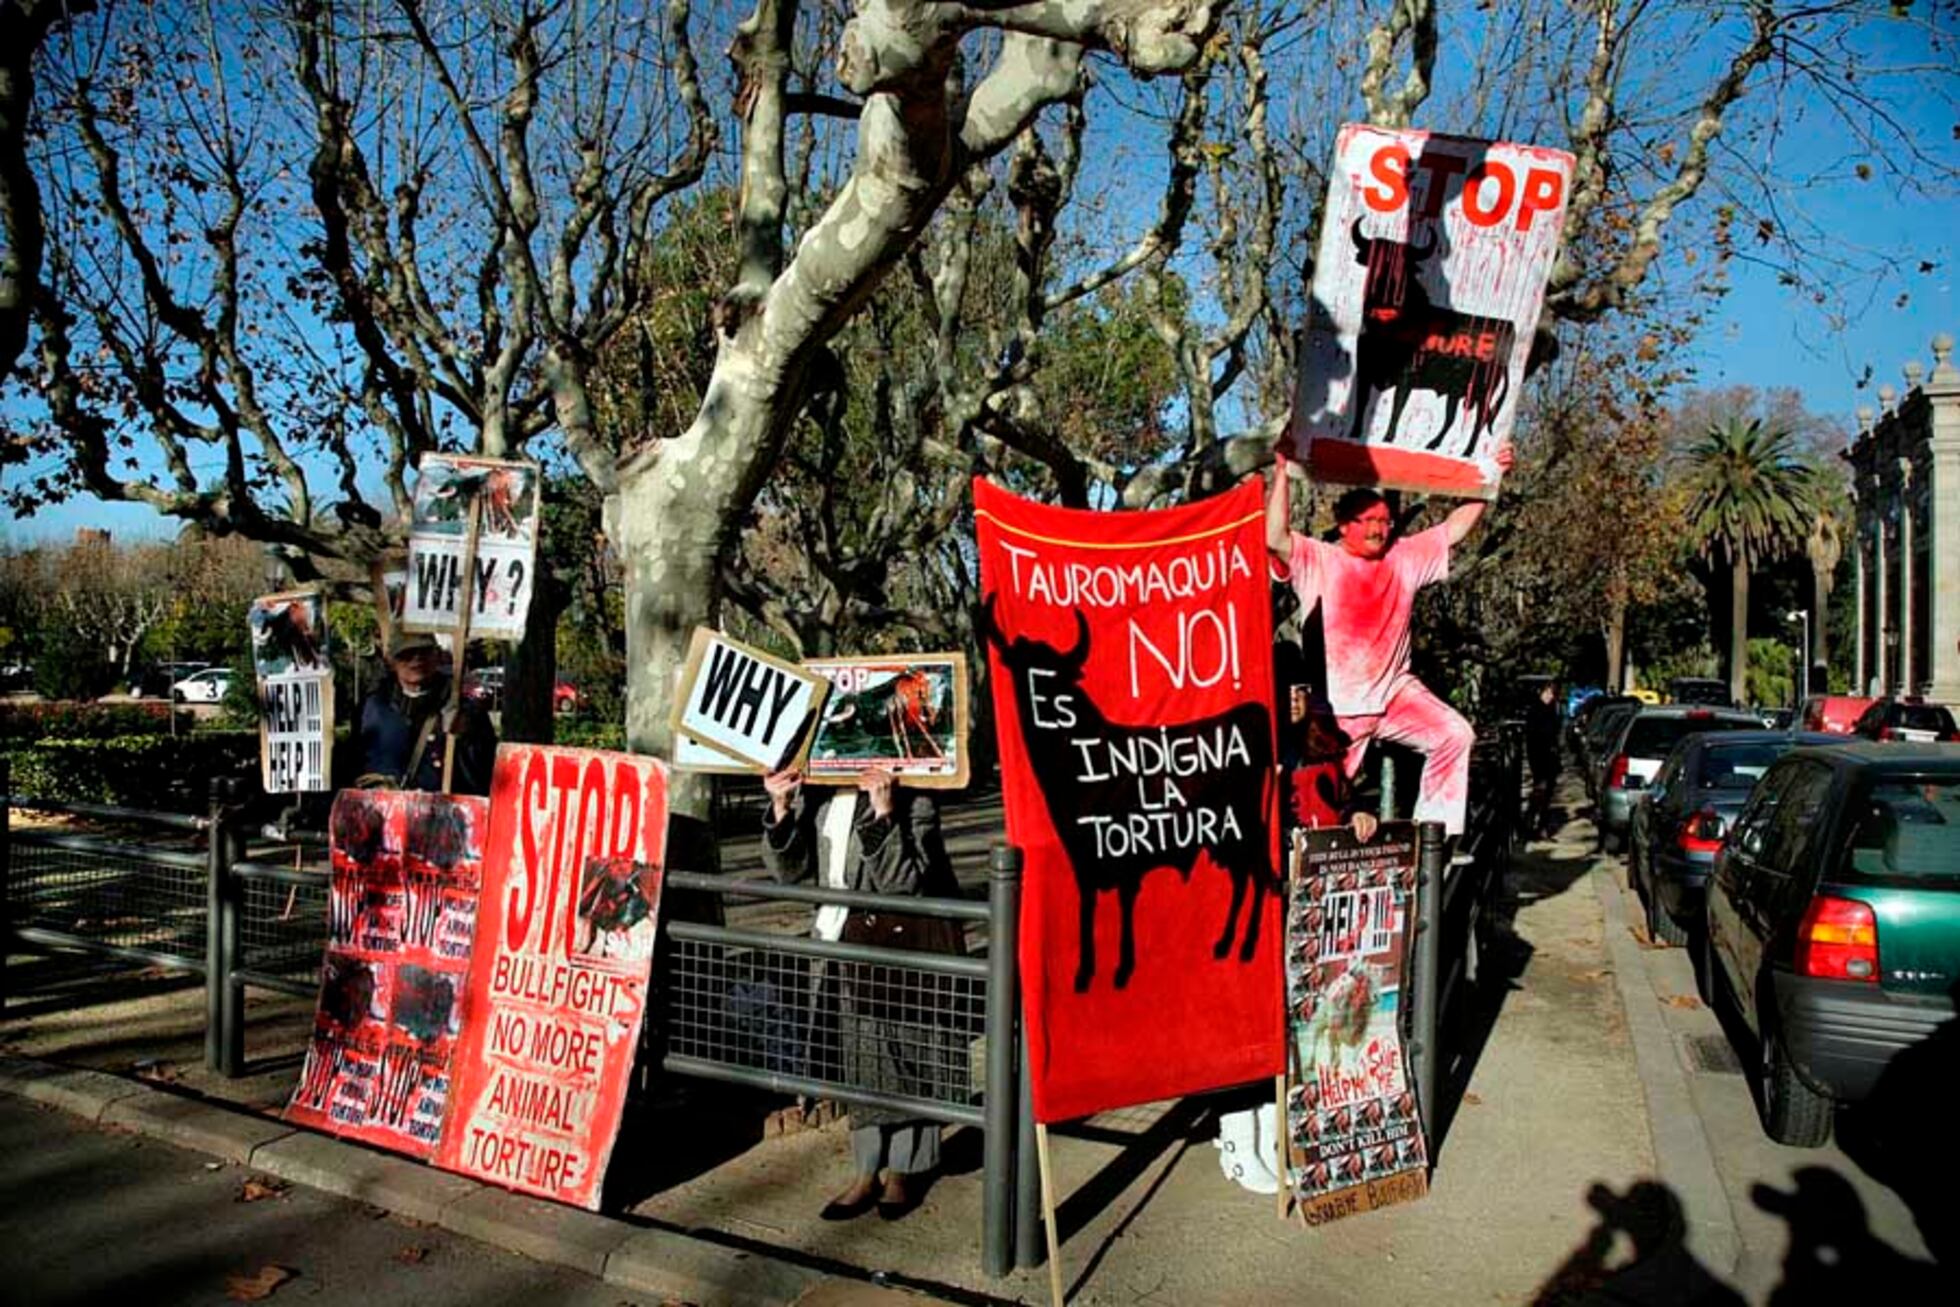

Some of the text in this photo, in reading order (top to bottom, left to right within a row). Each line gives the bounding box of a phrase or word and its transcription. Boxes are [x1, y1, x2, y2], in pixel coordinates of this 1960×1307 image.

[1362, 143, 1563, 233] STOP
[1128, 601, 1242, 698] NO!
[265, 683, 303, 733] HELP
[698, 643, 802, 748] WHY
[269, 741, 304, 790] HELP
[1138, 776, 1188, 810] LA
[1076, 804, 1243, 859] TORTURA
[1322, 892, 1369, 956] HELP
[493, 956, 643, 1020] BULLFIGHTS
[491, 1012, 601, 1075] NO MORE
[487, 1073, 575, 1132] ANIMAL
[468, 1127, 579, 1192] TORTURE
